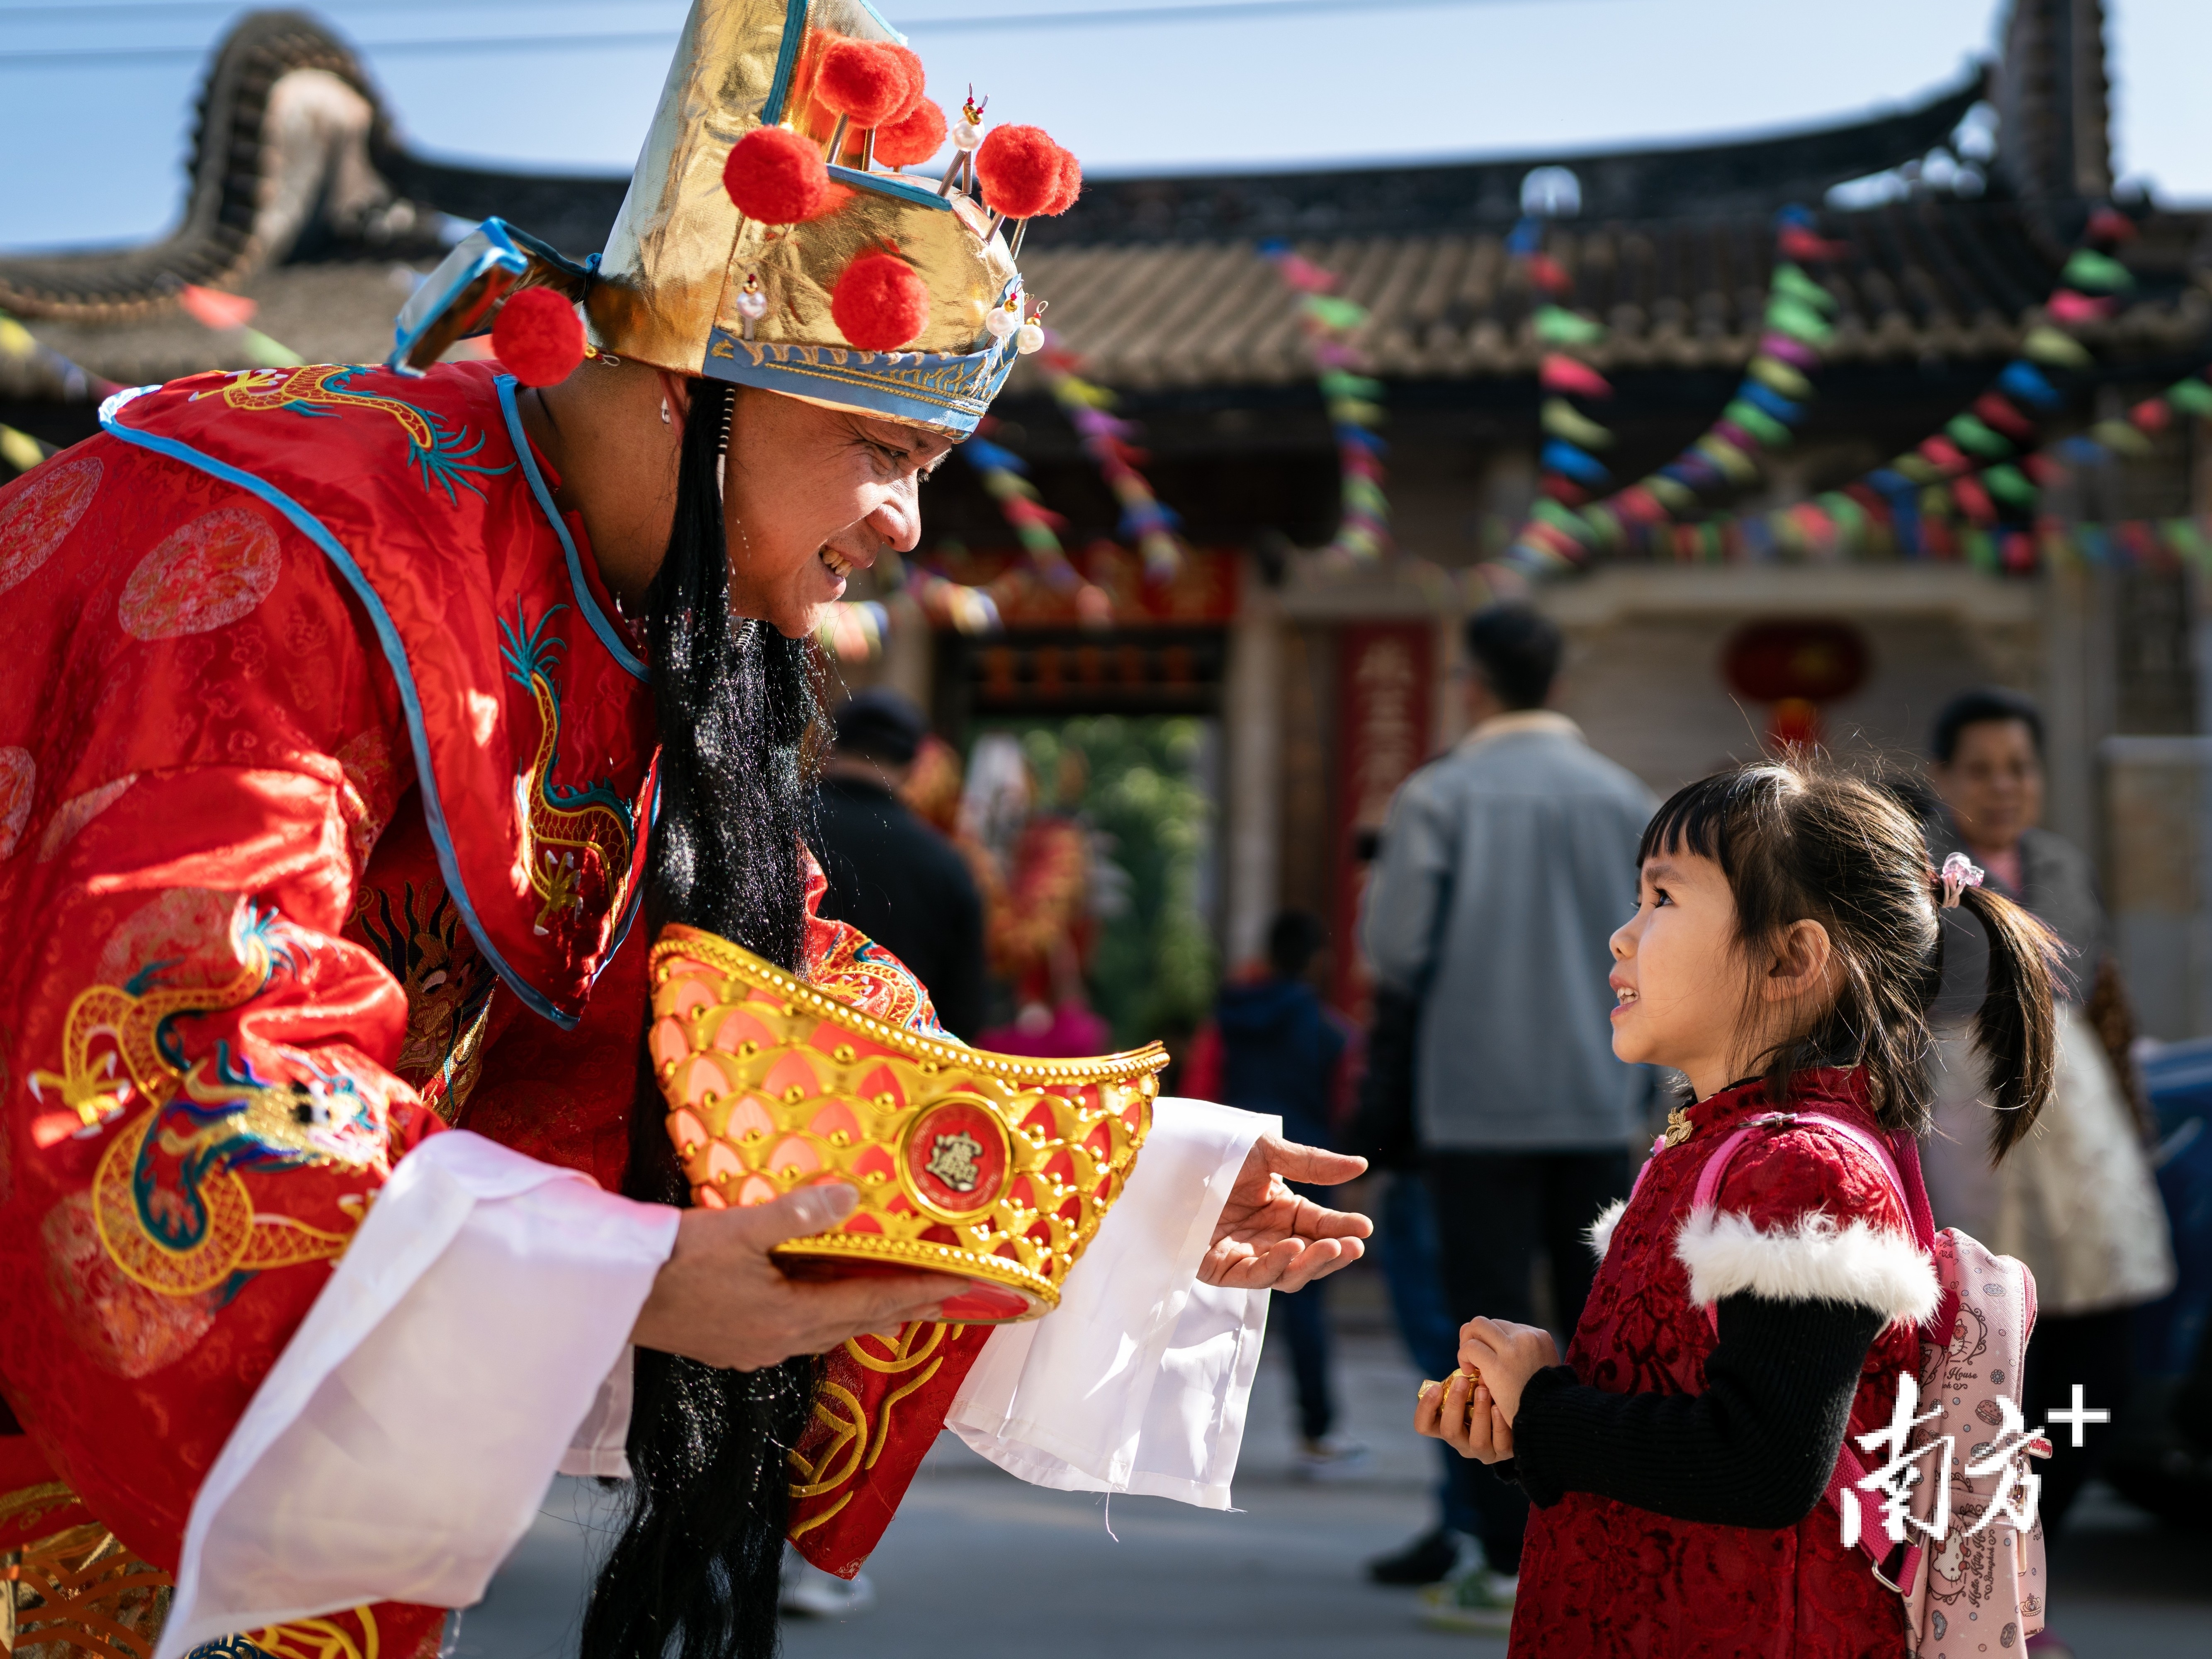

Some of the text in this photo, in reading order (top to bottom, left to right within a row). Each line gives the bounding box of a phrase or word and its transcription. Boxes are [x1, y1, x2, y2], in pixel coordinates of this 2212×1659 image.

[1947, 1367, 1977, 1381] House
[1968, 1529, 1986, 1608] Hello Kitty Hou
[1984, 1547, 1996, 1585] Bangkok
